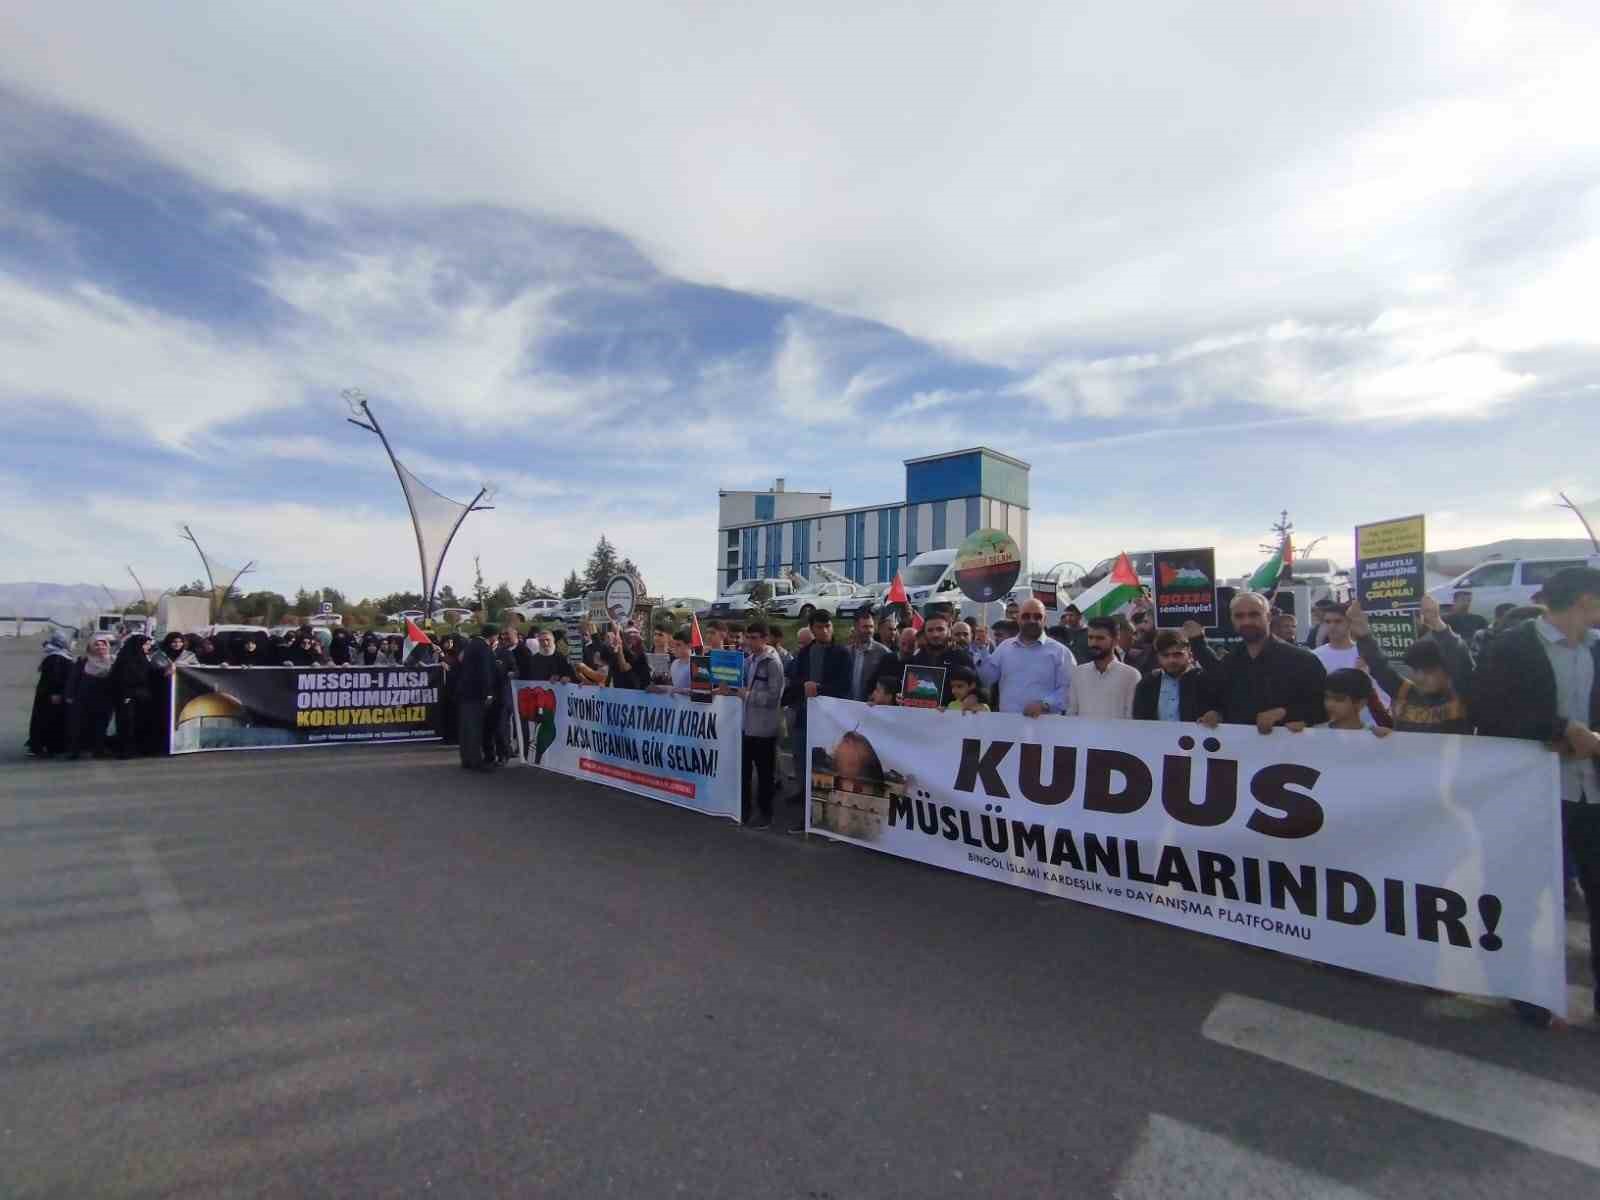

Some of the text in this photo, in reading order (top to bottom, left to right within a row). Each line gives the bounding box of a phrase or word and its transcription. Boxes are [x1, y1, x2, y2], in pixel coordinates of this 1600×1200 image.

[297, 688, 438, 709] ONURUMUZDUR!
[387, 671, 428, 688] AKSA
[567, 692, 718, 740] SİYONİST KUŞATMAYI KIRAN
[566, 725, 718, 777] AKSA TUFANINA BİN SELAM!
[953, 735, 1324, 839] KUDÜS
[887, 790, 1503, 952] MÜSLÜMANLARINDIR!
[967, 852, 1312, 940] BİNGÖL İSLAMİ KARDEŞLİK ve DAYANIŞMA PLATFORMU
